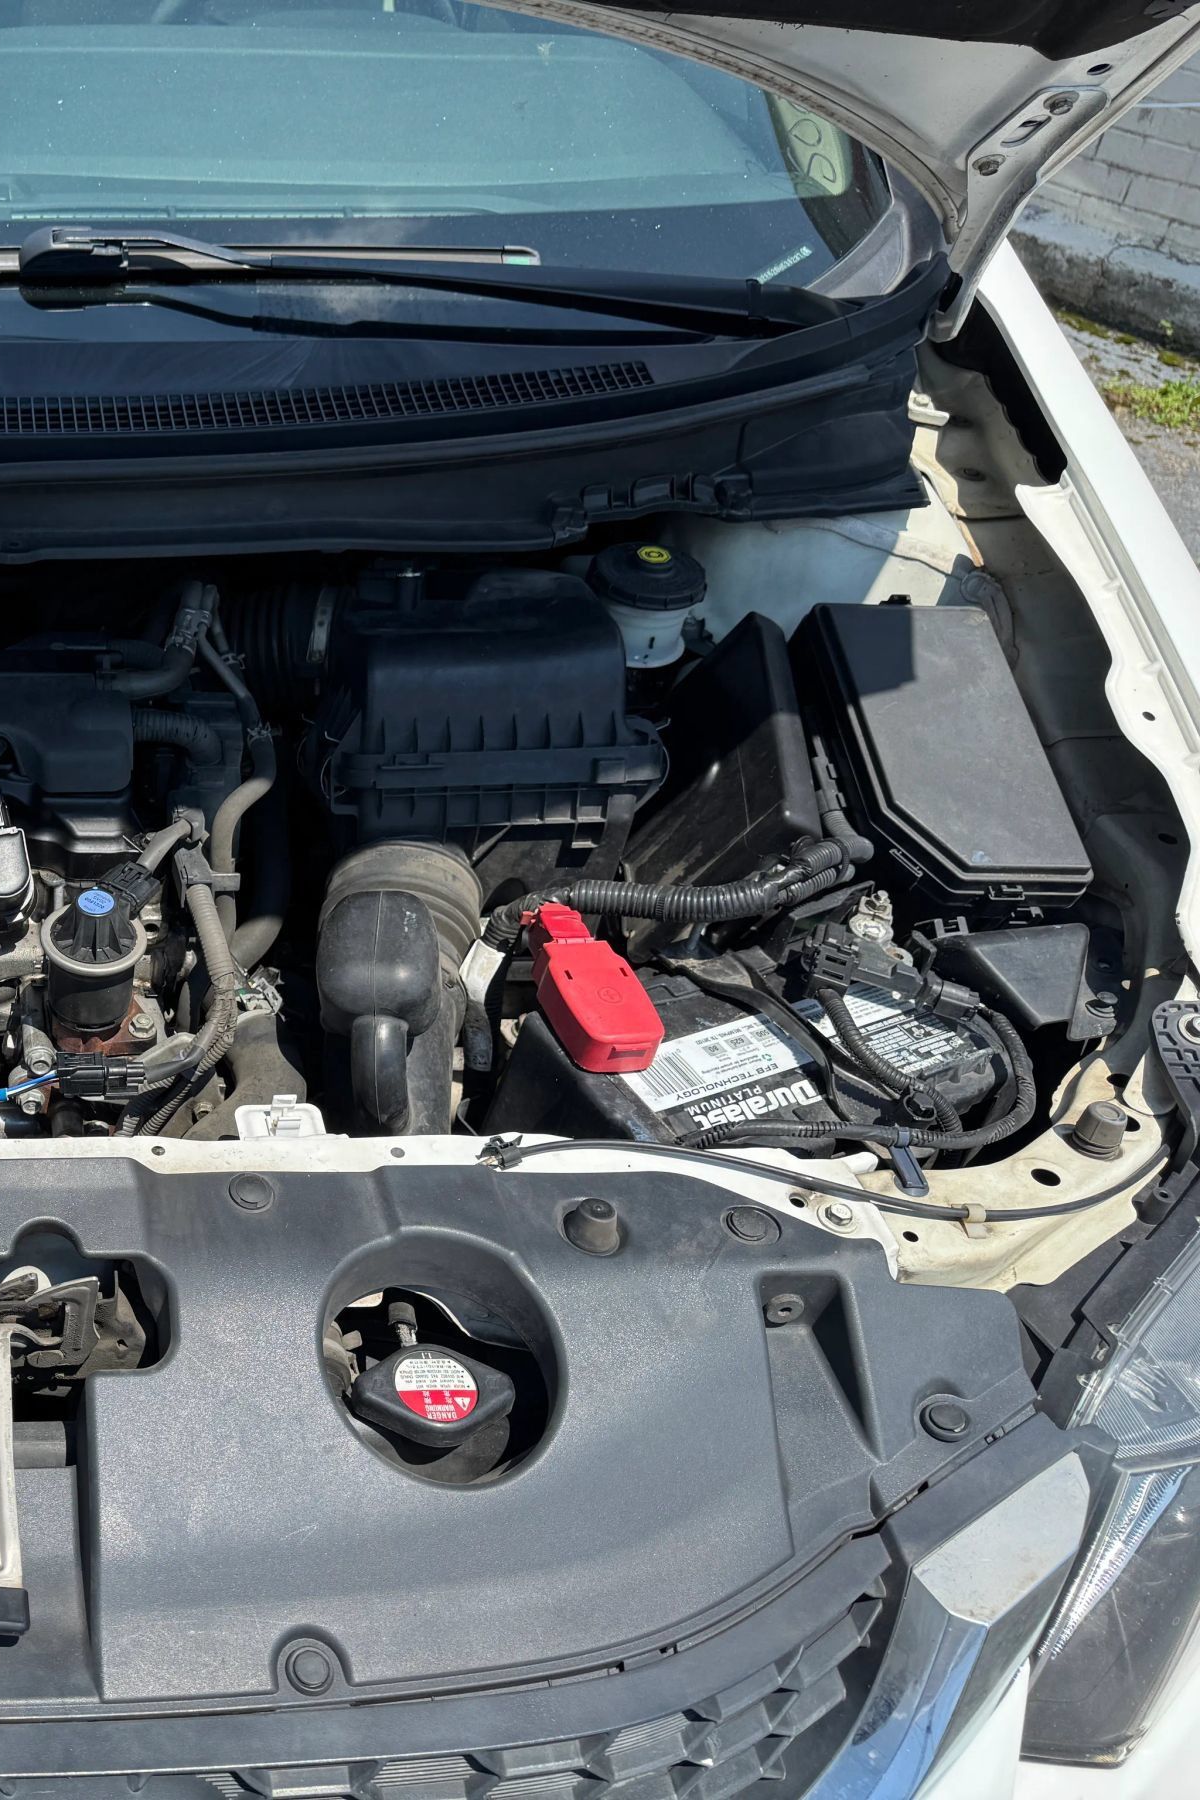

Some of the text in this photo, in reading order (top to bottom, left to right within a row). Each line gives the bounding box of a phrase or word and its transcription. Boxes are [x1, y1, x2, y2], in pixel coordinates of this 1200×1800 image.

[708, 1045, 719, 1053] 80
[730, 1036, 745, 1047] 625
[676, 1062, 779, 1101] EFB TECHNOLOGY
[688, 1084, 763, 1116] PLATINUM
[692, 1079, 823, 1130] Duralast
[427, 1411, 457, 1420] DANGER
